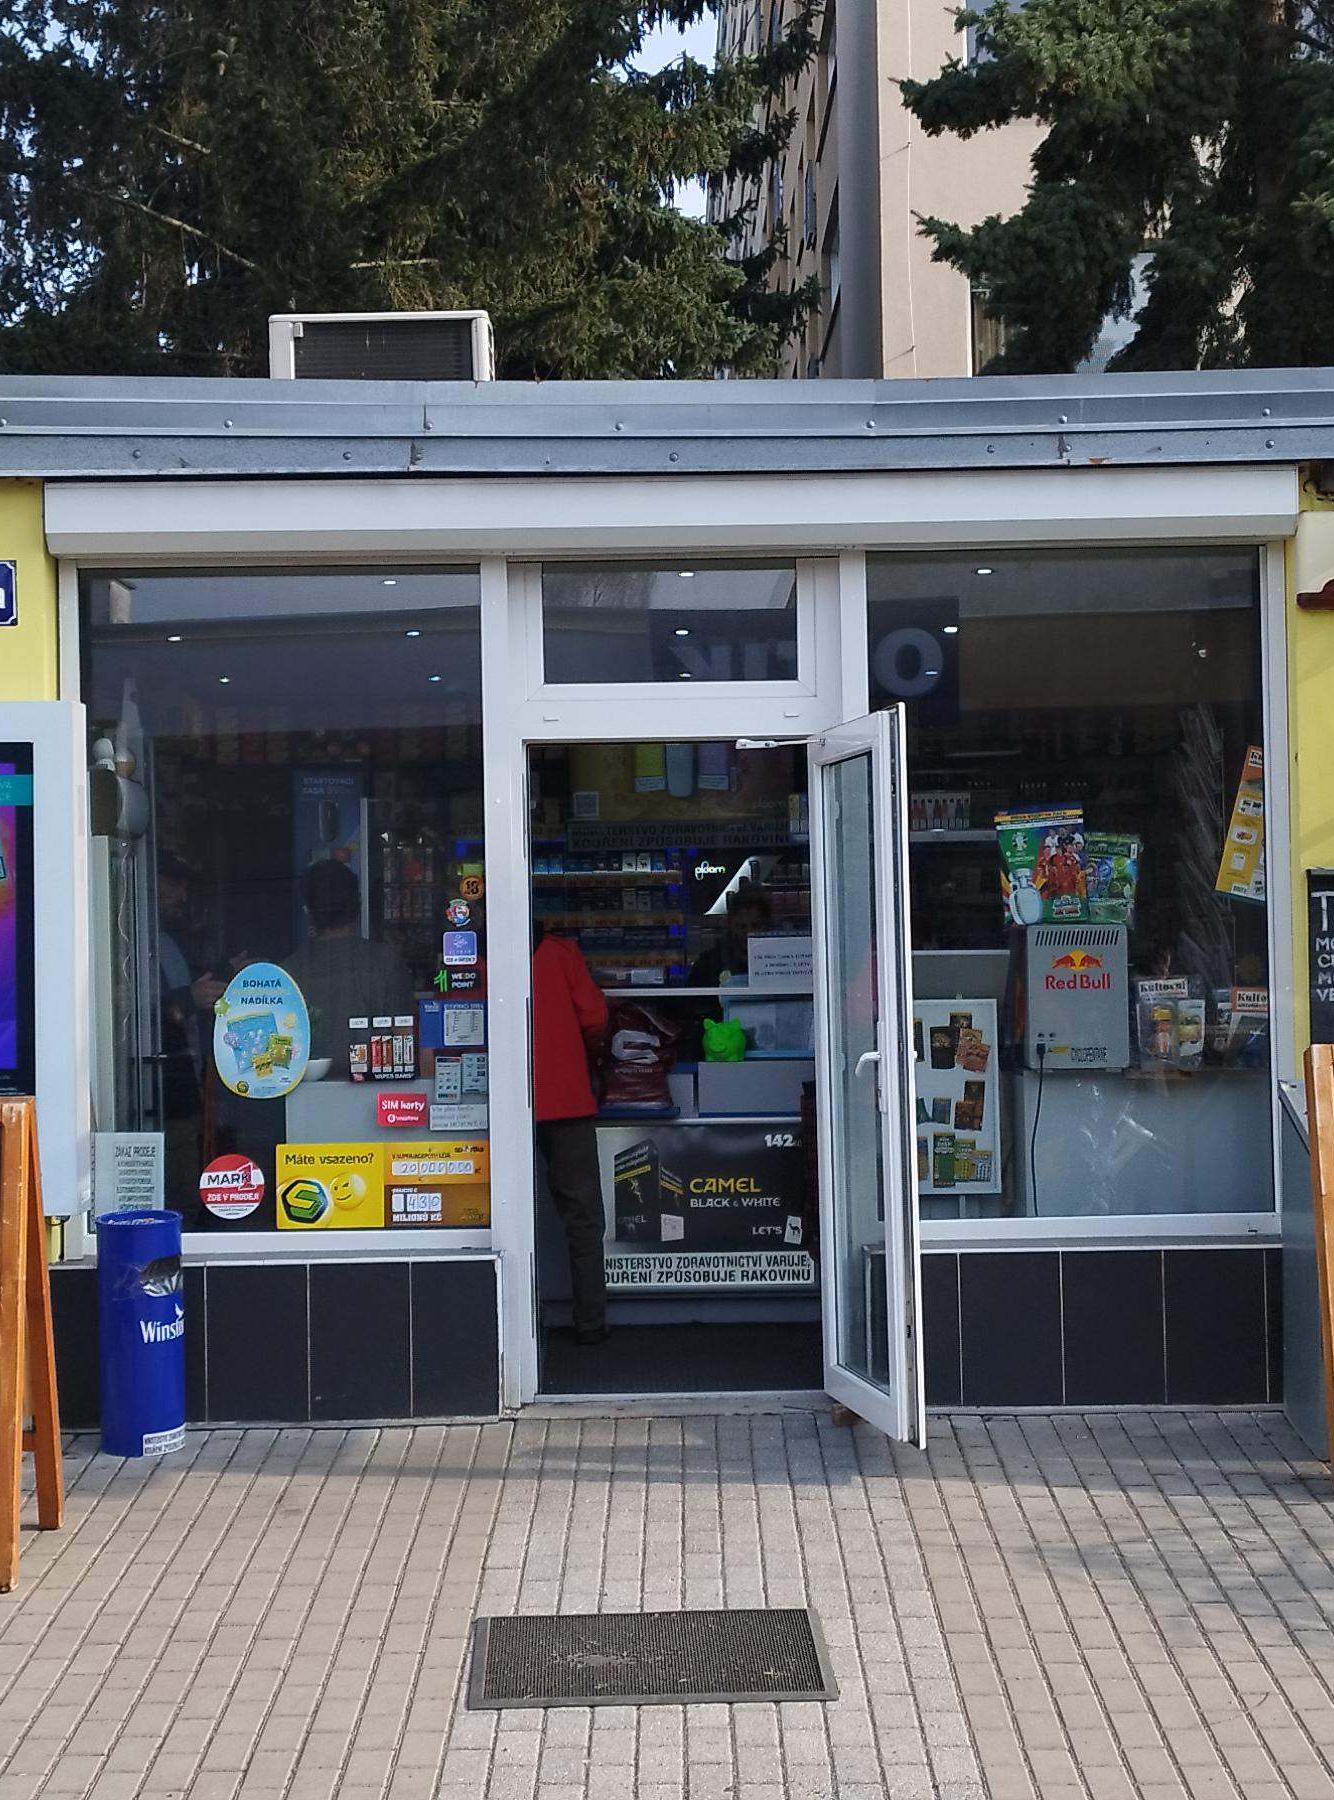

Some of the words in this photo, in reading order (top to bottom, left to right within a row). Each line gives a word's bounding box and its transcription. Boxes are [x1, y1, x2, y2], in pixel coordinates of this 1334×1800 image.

[242, 978, 283, 989] BOHATÁ
[1045, 973, 1077, 990] Red
[1079, 972, 1111, 990] Bull
[240, 995, 284, 1006] NADÍLKA
[1237, 991, 1268, 1002] Kulto
[381, 1099, 400, 1111] SIM
[400, 1099, 425, 1112] karty
[763, 1133, 795, 1149] 142
[284, 1153, 316, 1165] Máte
[319, 1151, 375, 1165] vsazeno?
[689, 1176, 763, 1194] CAMEL
[690, 1197, 731, 1209] BLACK
[741, 1196, 782, 1208] WHITE
[751, 1225, 783, 1236] LET'S
[605, 1256, 673, 1271] NISTERSTVO
[676, 1253, 763, 1269] ZDRAVOTNICTVÍ
[604, 1269, 653, 1285] OUŘENÍ
[656, 1268, 736, 1284] ZPŮSOBUJE
[740, 1267, 811, 1283] RAKOVINU
[139, 1317, 185, 1344] Winsto
